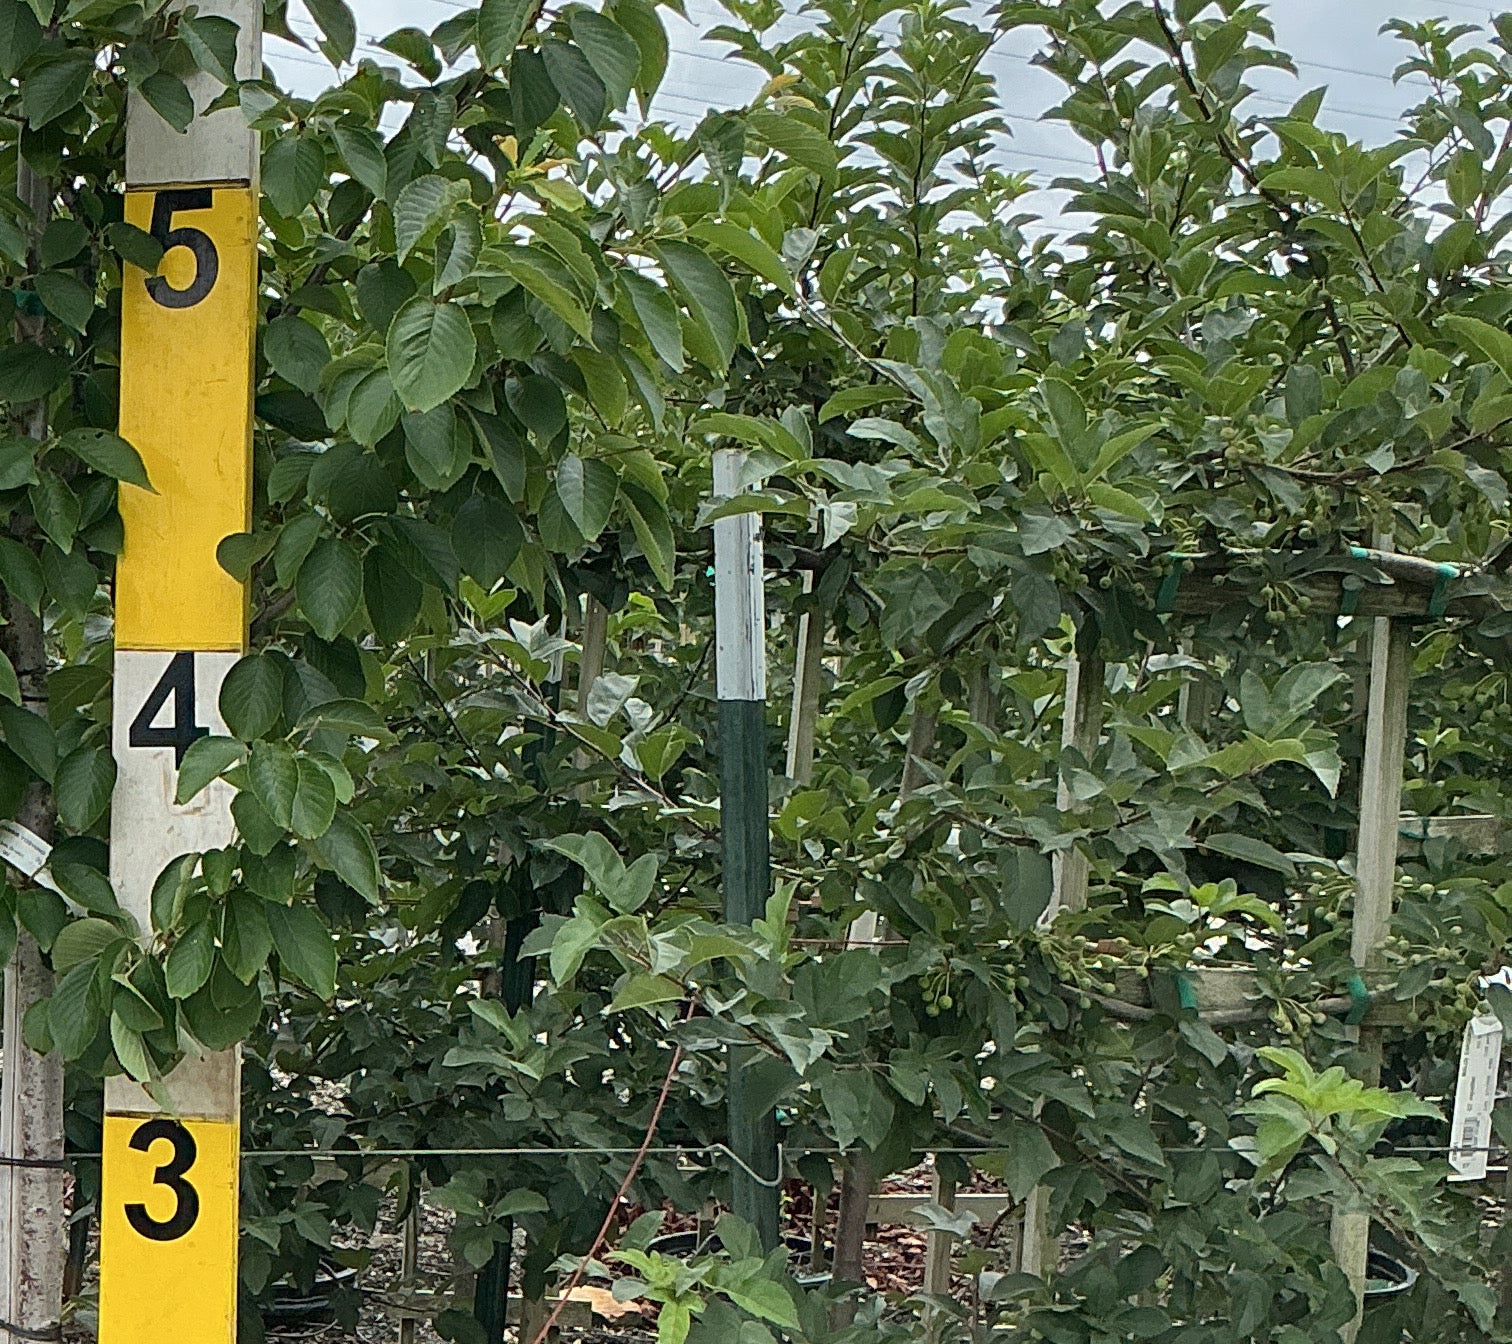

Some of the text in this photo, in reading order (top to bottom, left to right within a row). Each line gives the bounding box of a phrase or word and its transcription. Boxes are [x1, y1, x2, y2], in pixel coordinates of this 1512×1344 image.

[144, 187, 219, 309] 5
[129, 650, 211, 770] 4
[124, 1118, 200, 1242] 3
